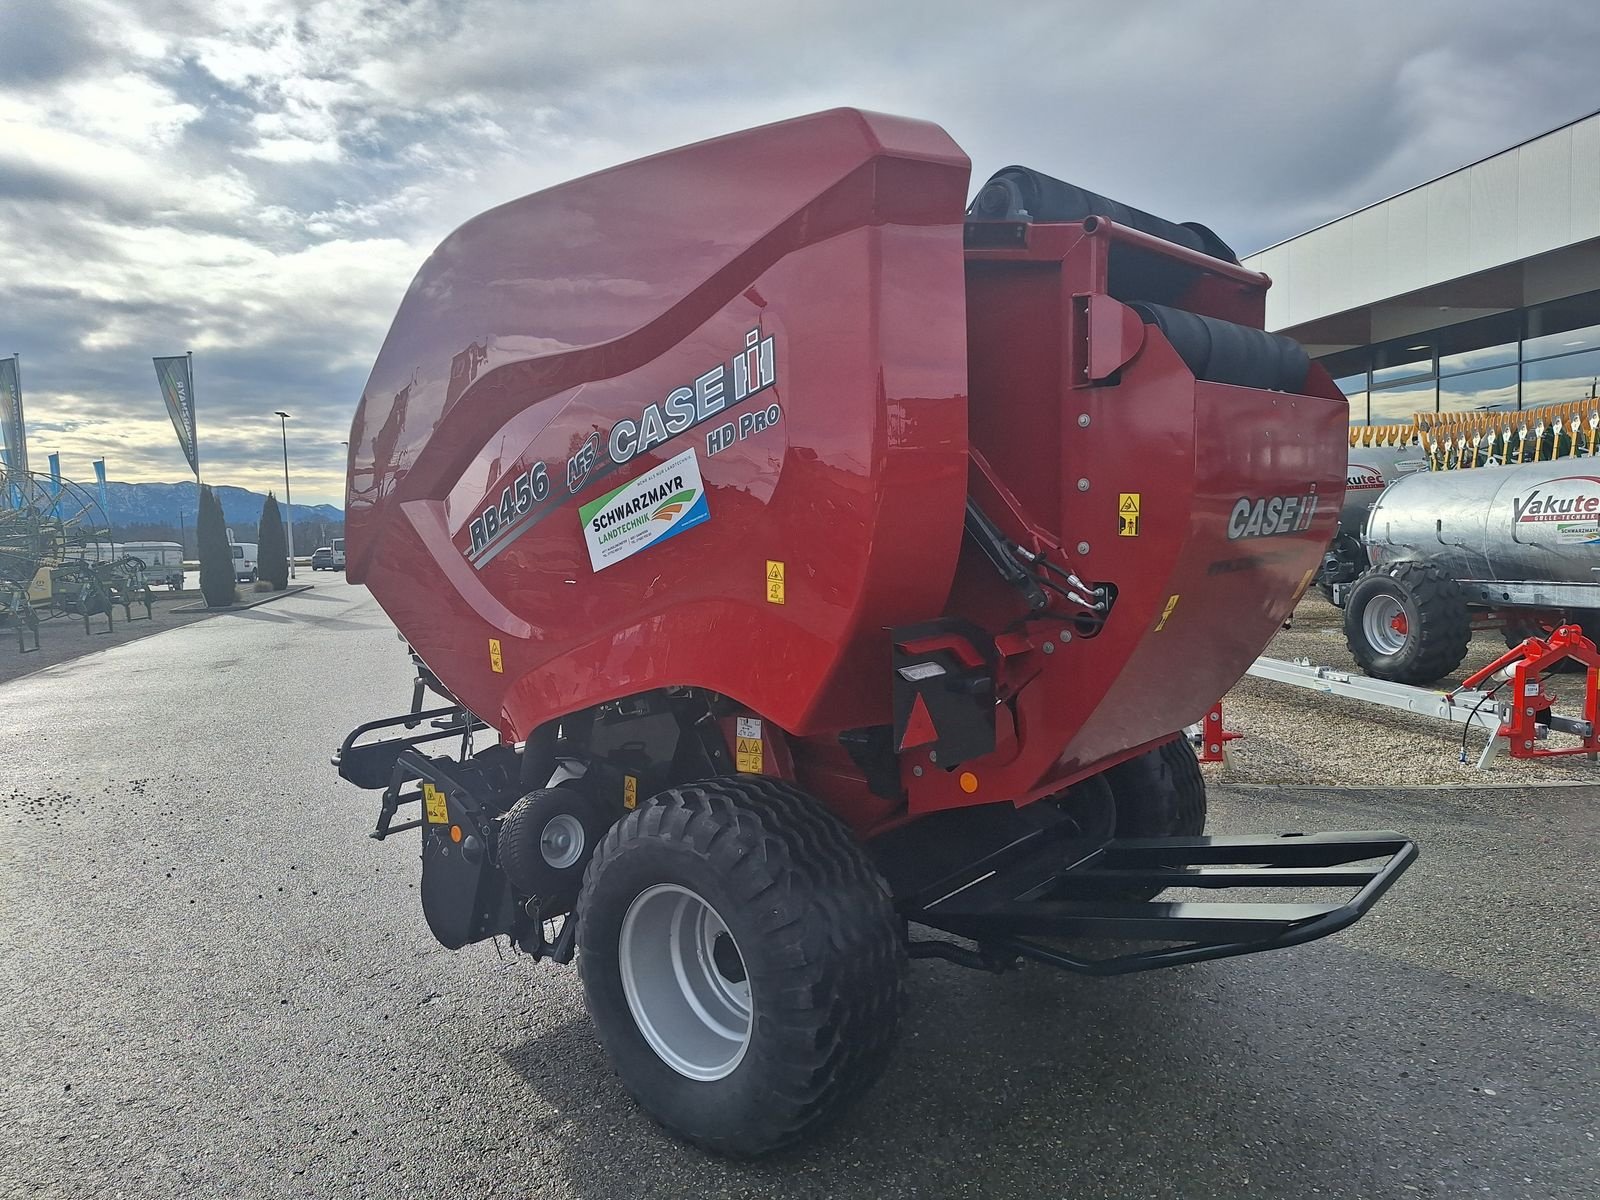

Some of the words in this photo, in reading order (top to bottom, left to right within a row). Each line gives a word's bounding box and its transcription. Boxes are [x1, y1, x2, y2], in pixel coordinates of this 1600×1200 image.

[608, 365, 726, 464] CASE
[706, 423, 736, 457] HD
[566, 441, 597, 487] AFS
[468, 461, 550, 554] RB456
[592, 475, 684, 533] SCHWARZMAYR
[1228, 497, 1299, 540] CASE
[598, 512, 651, 545] LANDTECHNIK
